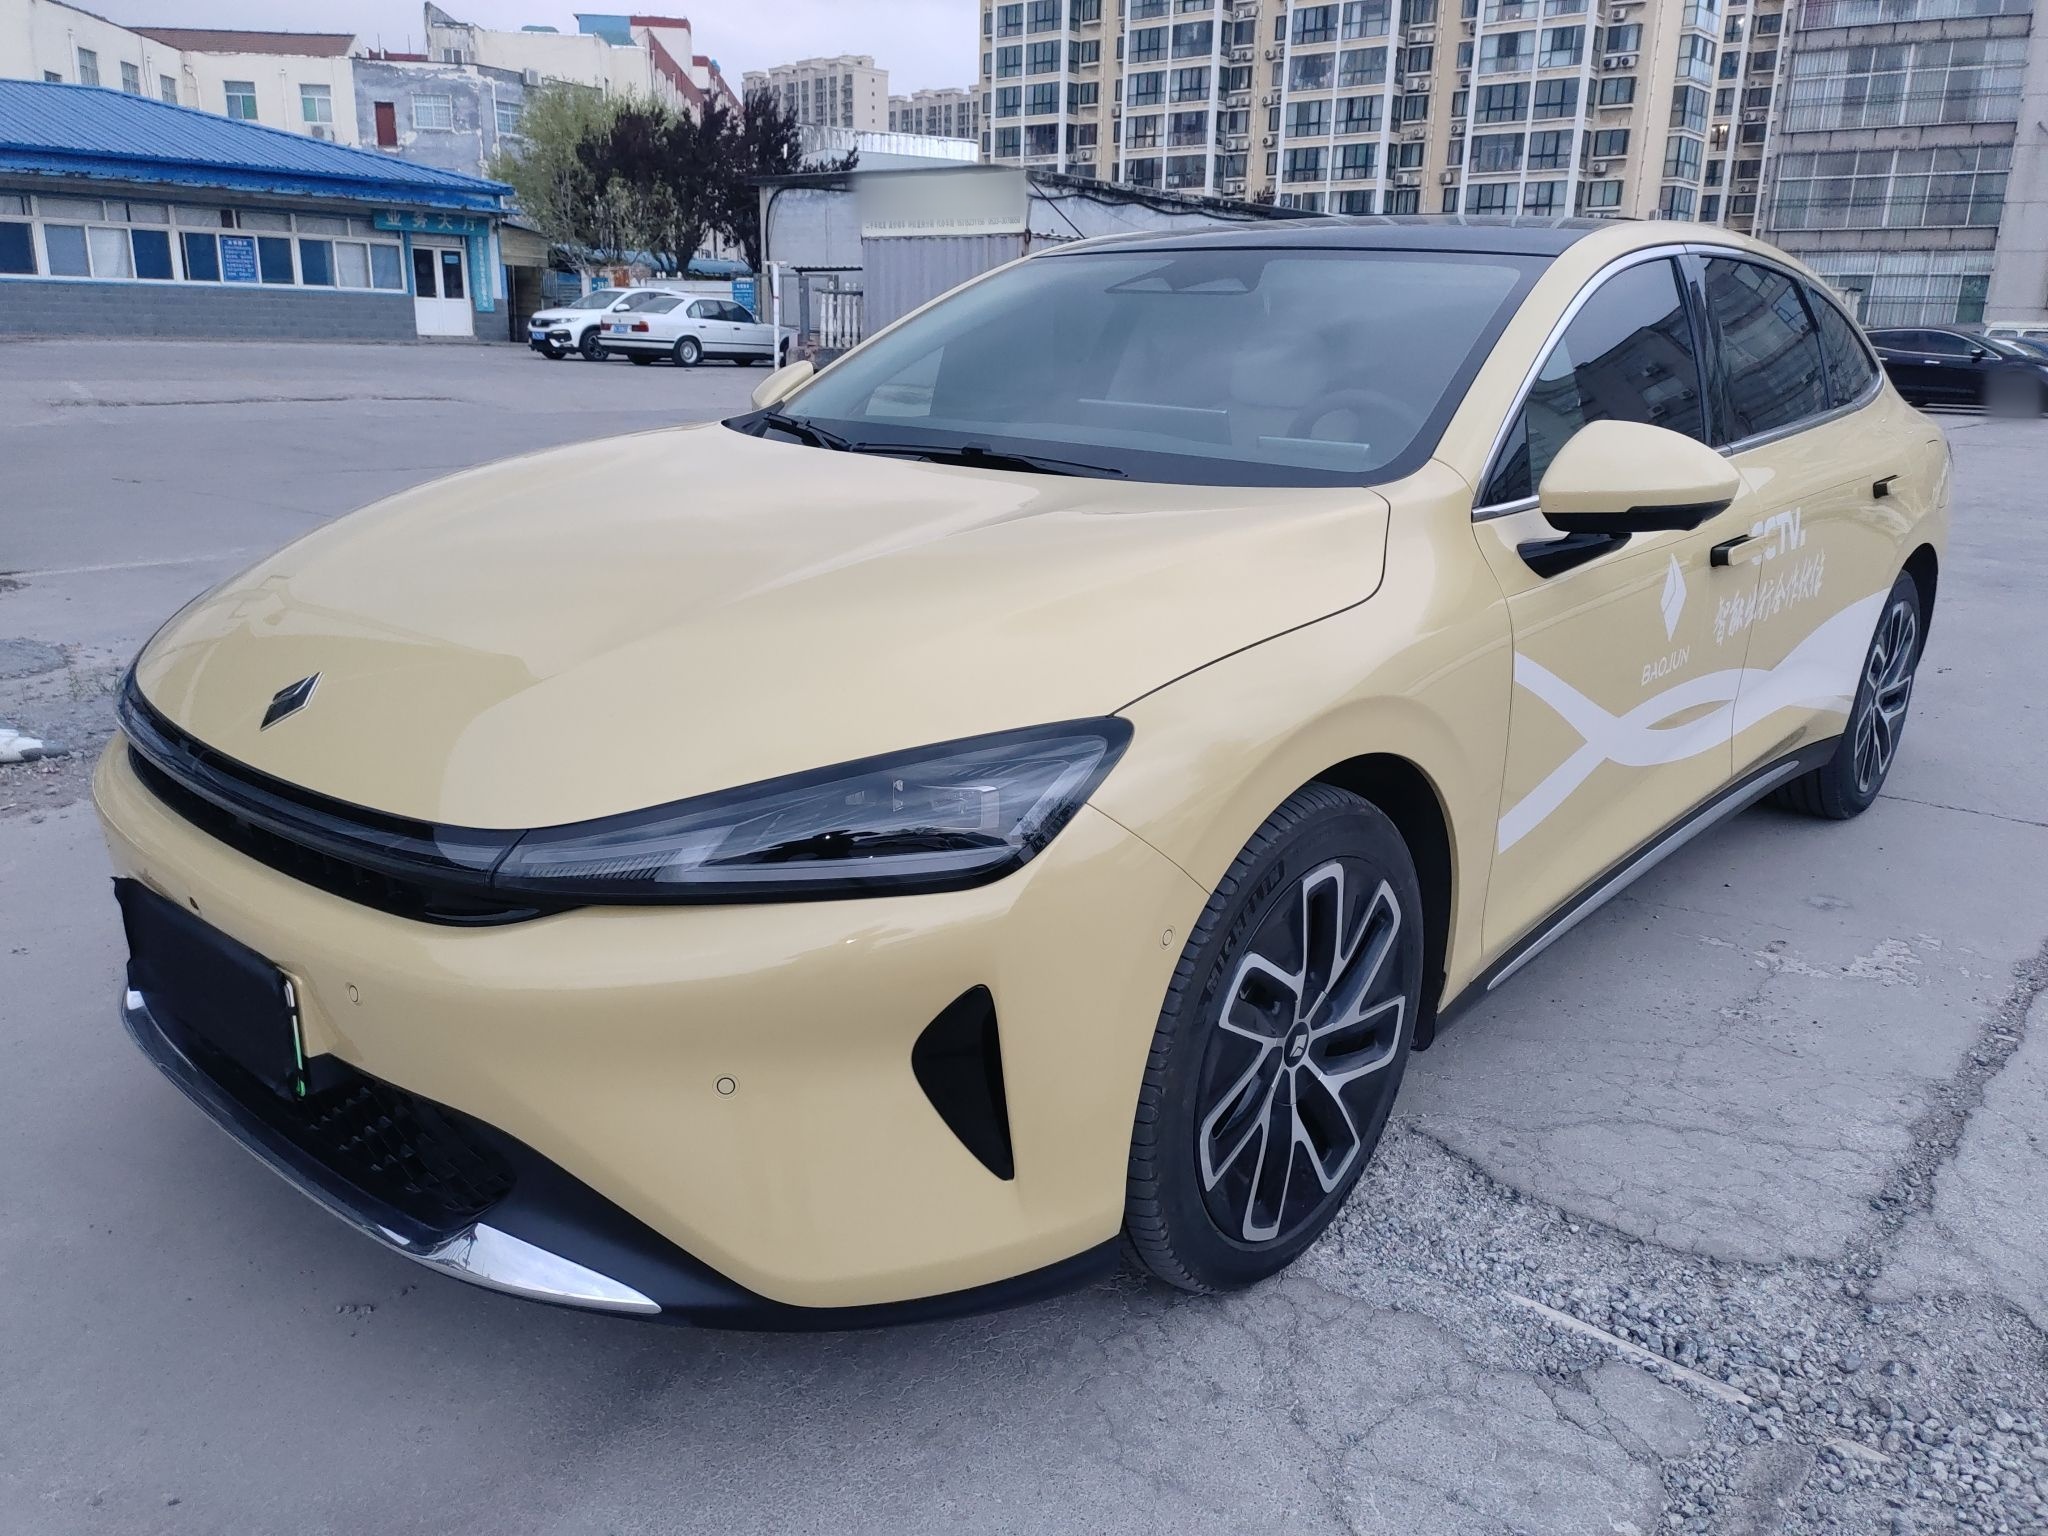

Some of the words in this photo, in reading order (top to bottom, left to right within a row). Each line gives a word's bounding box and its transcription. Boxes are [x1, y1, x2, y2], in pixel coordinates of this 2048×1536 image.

[385, 209, 475, 231] 业务大厅
[1641, 645, 1690, 686] BAOJUN
